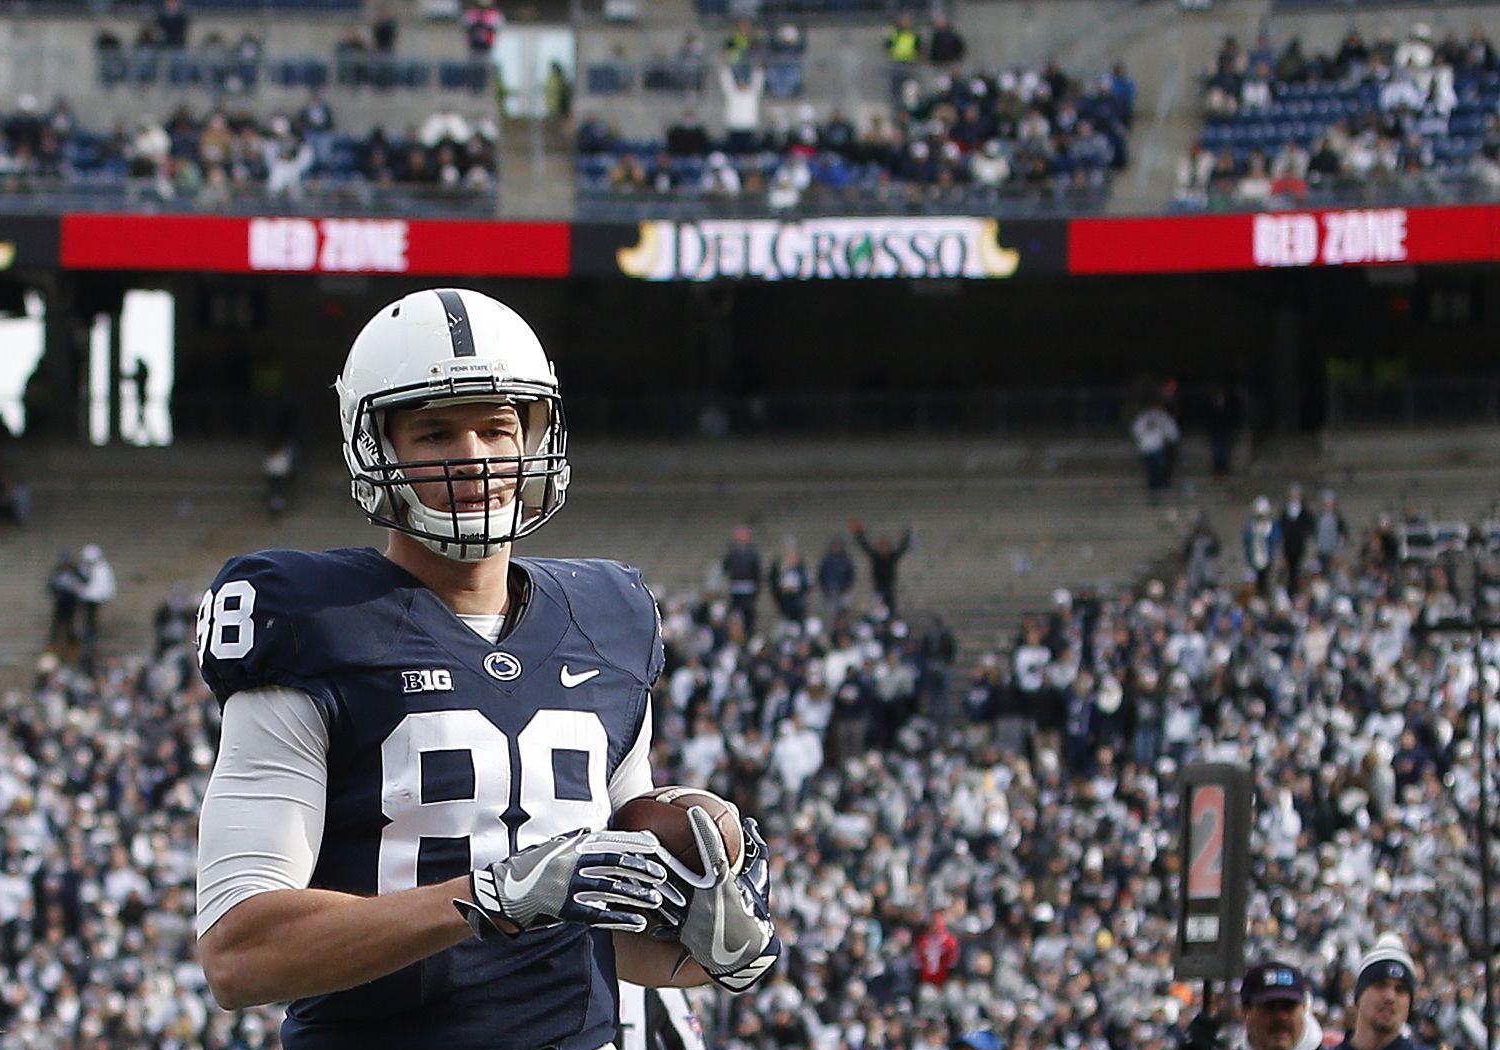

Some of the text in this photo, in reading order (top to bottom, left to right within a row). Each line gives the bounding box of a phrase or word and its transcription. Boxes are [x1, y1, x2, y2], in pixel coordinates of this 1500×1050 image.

[248, 218, 409, 271] RED ZONE
[1253, 208, 1408, 266] RED ZONE
[378, 709, 612, 897] 88
[1187, 785, 1226, 898] 2
